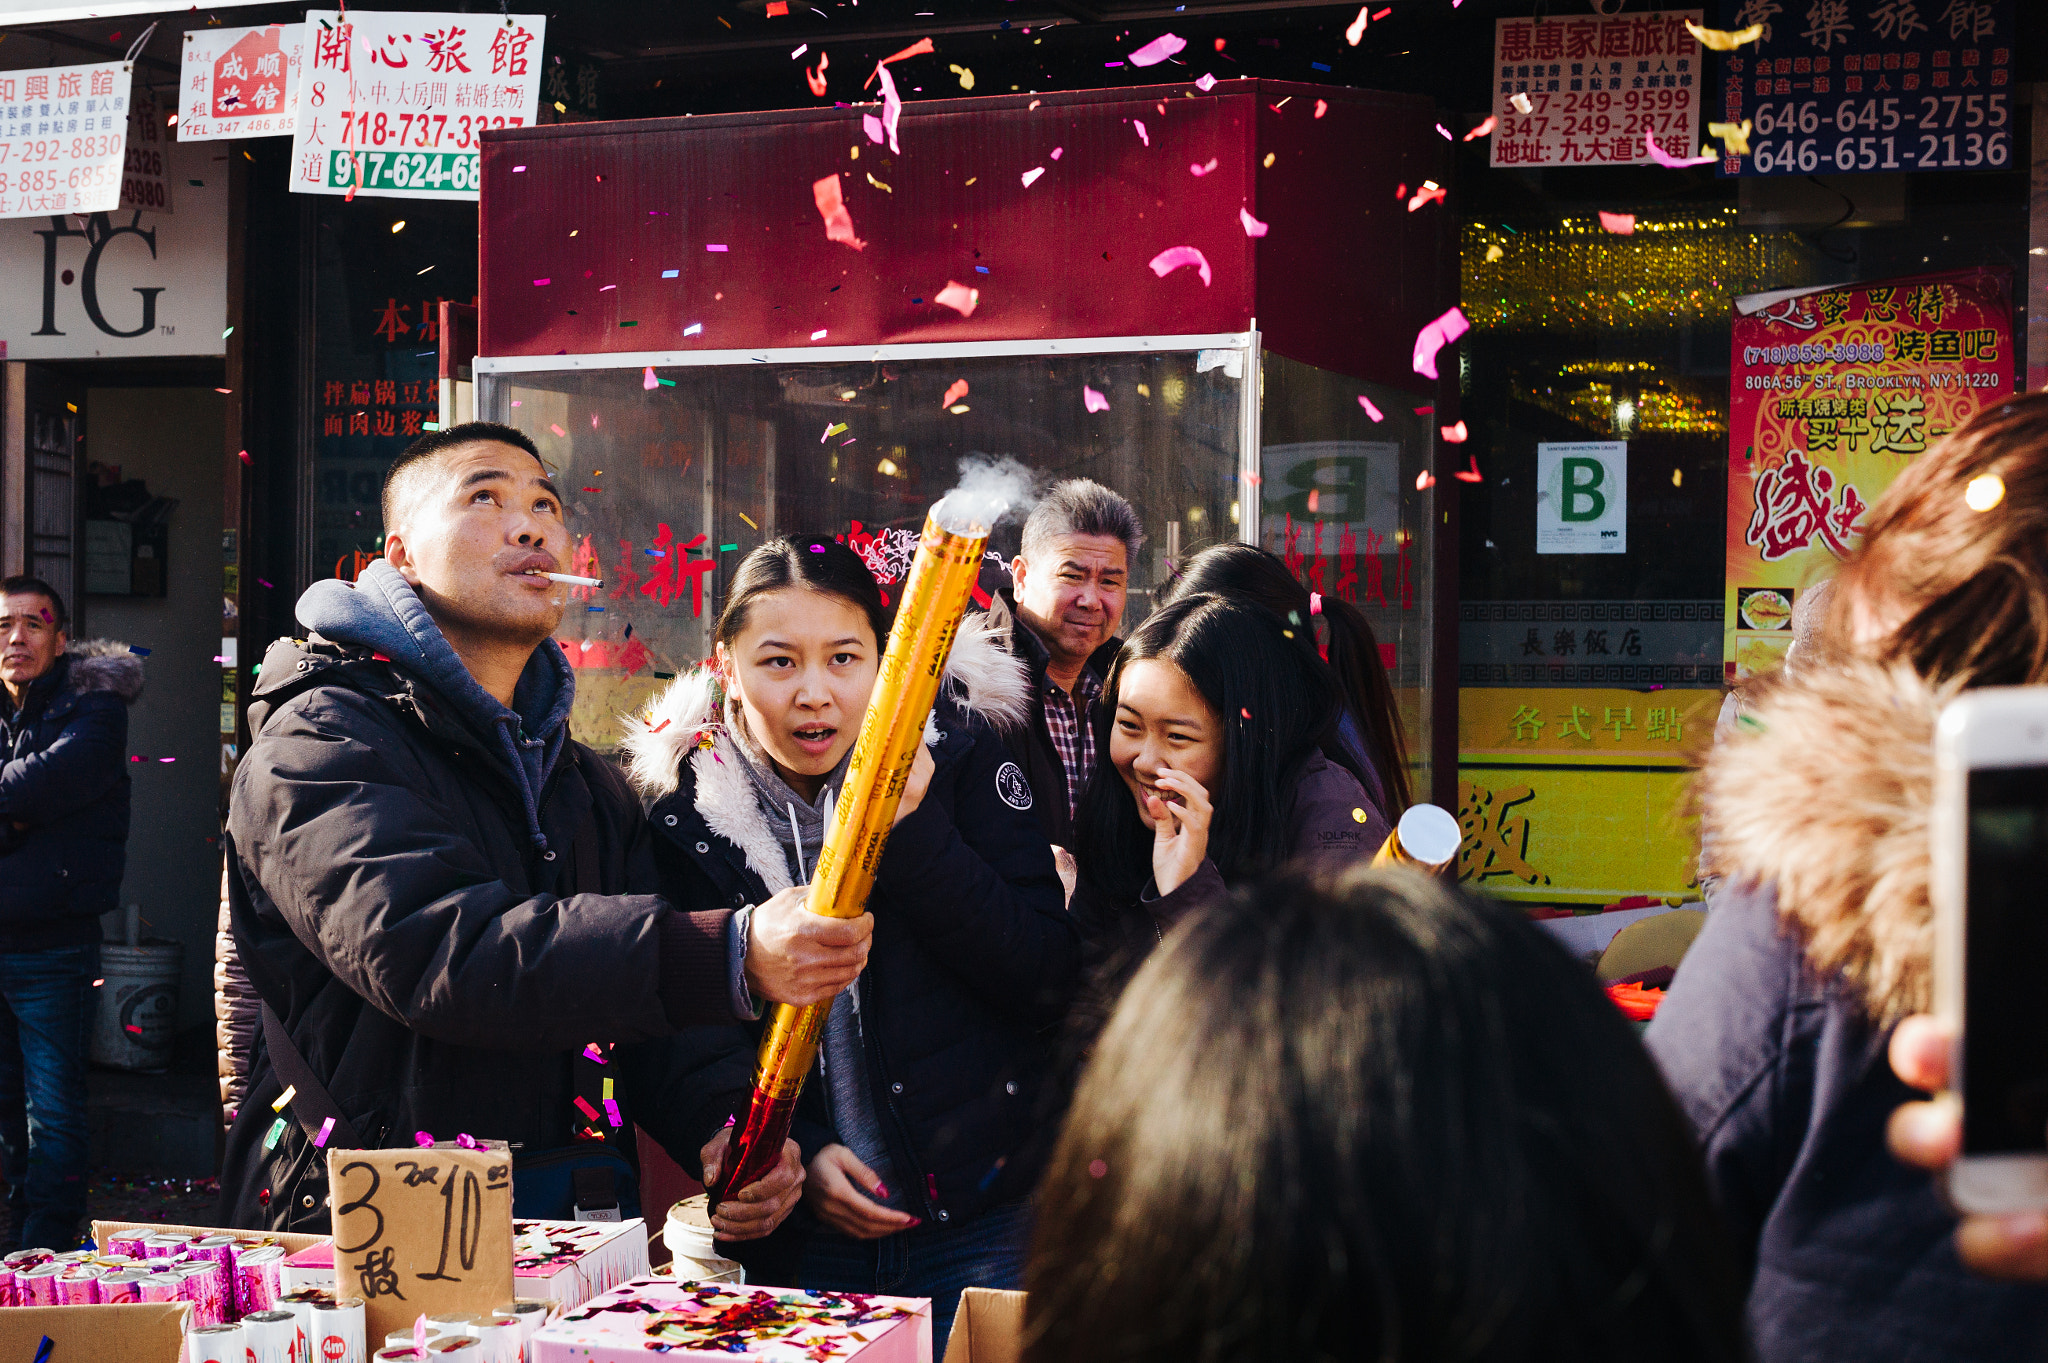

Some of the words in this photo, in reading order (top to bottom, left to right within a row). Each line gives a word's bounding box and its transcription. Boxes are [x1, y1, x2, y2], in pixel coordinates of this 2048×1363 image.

[314, 24, 534, 77] 開心旅館
[1500, 16, 1697, 62] 惠惠家庭旅馆
[455, 83, 525, 110] 結婚套房
[1503, 89, 1690, 115] 37-249-9599
[300, 81, 326, 184] 8大道
[1502, 112, 1689, 138] 347-249-2874
[1755, 94, 2008, 136] 646-645-2755
[1753, 132, 2008, 174] 646-651-2136
[1743, 343, 1886, 367] (718)853-3988
[1892, 328, 1998, 363] 烤鱼吧
[1745, 375, 1782, 390] 806A
[1930, 373, 1951, 388] NY
[1955, 372, 1999, 388] 11220
[1562, 457, 1606, 522] B
[1519, 627, 1642, 656] 長樂飯店
[1511, 705, 1683, 742] 各式早點
[1318, 831, 1361, 841] NDLPRK
[336, 1162, 384, 1253] 3
[323, 1341, 343, 1354] 4m
